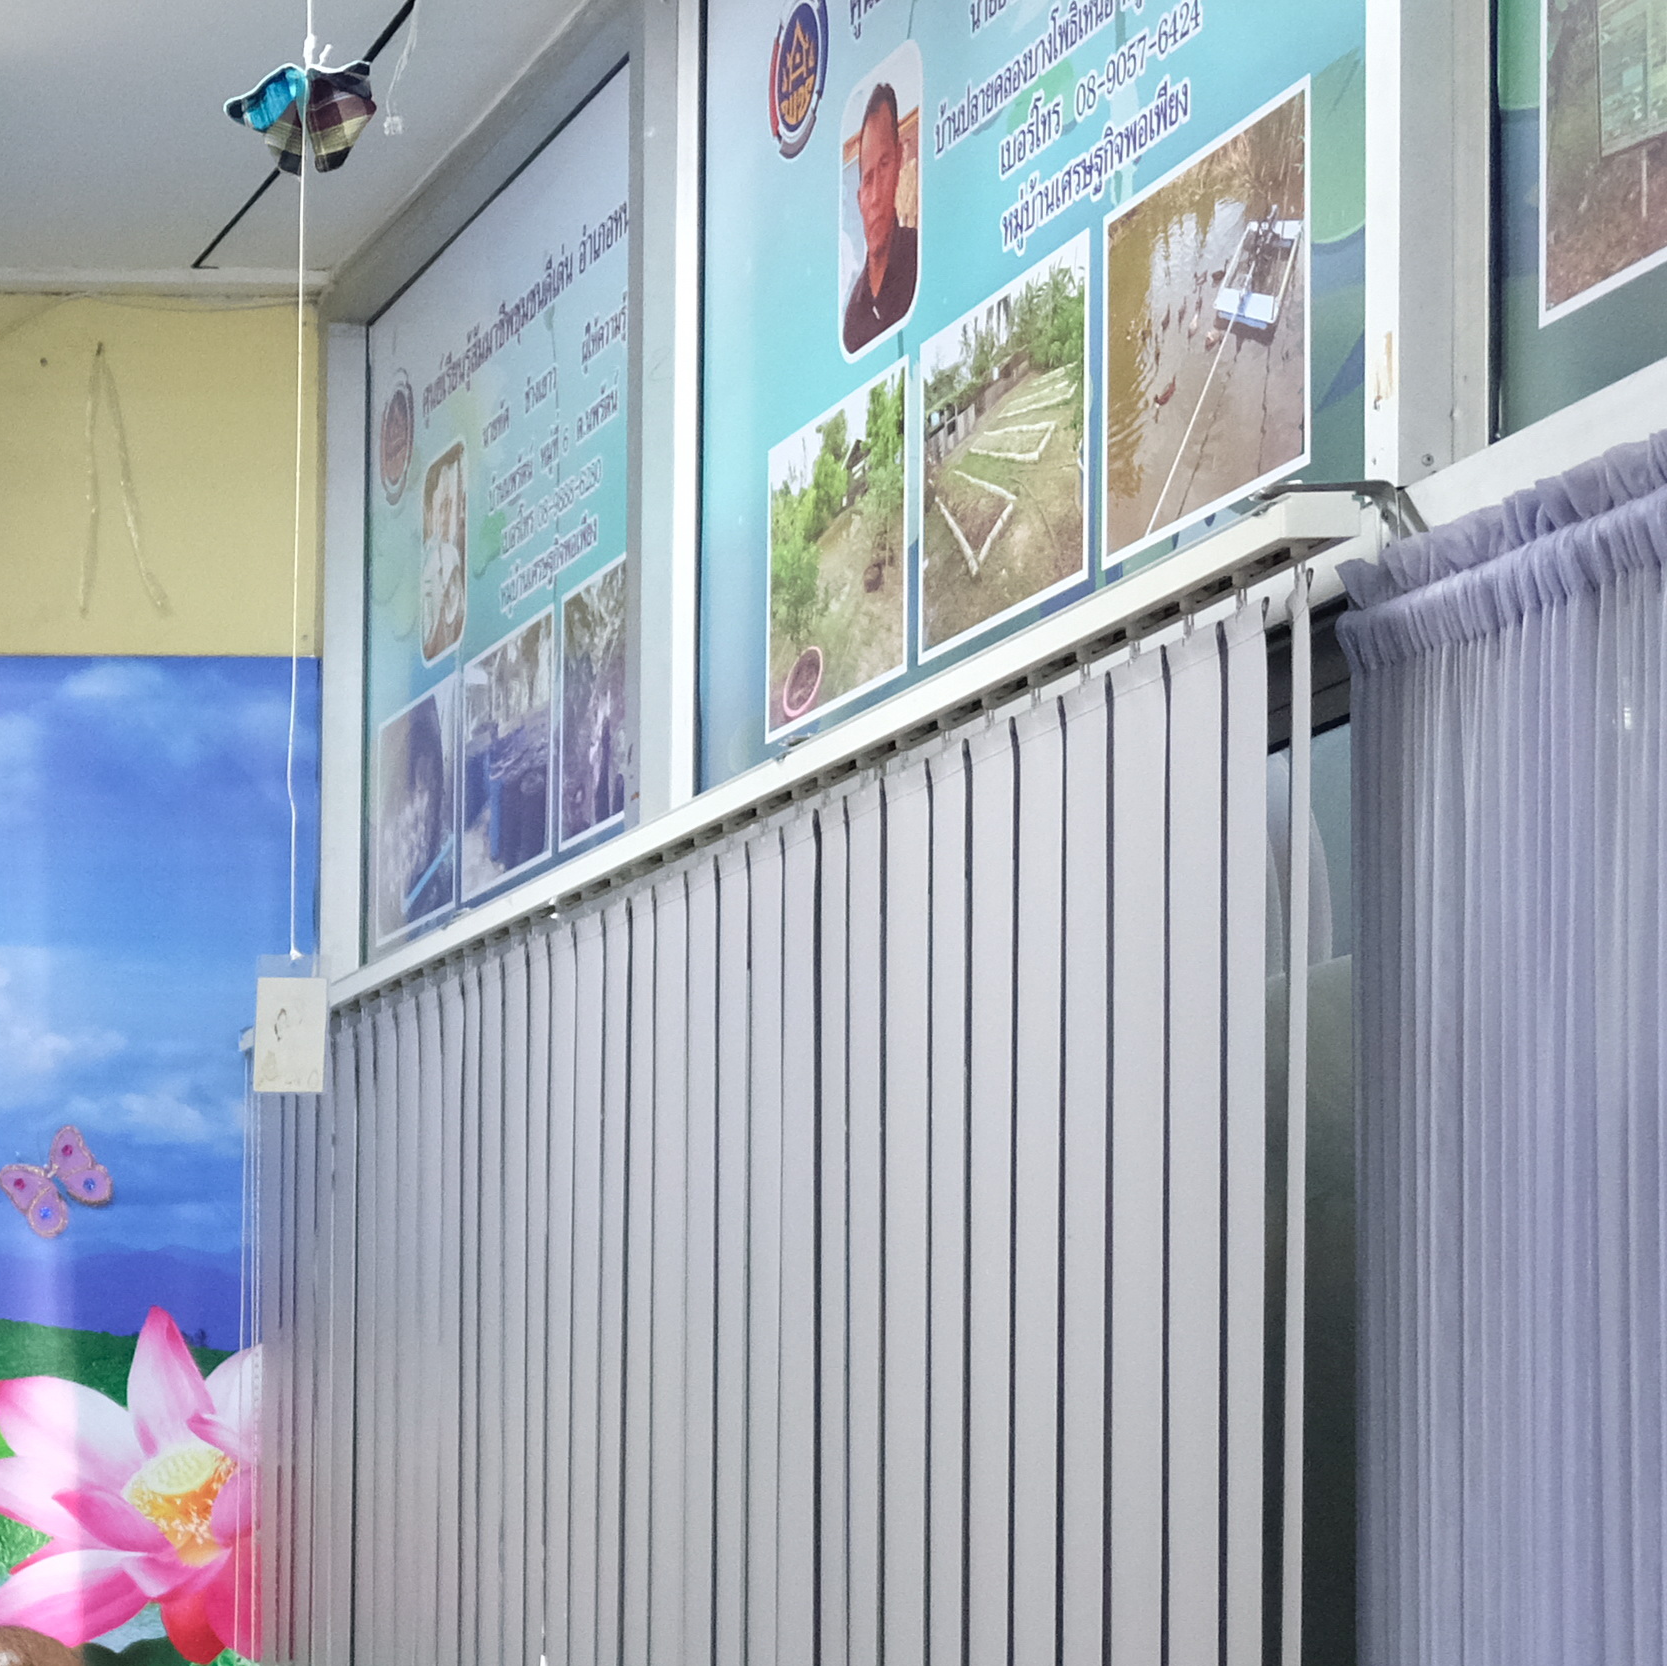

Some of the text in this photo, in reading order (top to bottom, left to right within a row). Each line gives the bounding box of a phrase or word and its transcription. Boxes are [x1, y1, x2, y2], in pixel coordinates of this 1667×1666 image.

[999, 3, 1202, 177] เบอร์โทร 08-9057-6424
[1001, 76, 1190, 248] หมู่บ้านเศรษฐกิจพอเพียง
